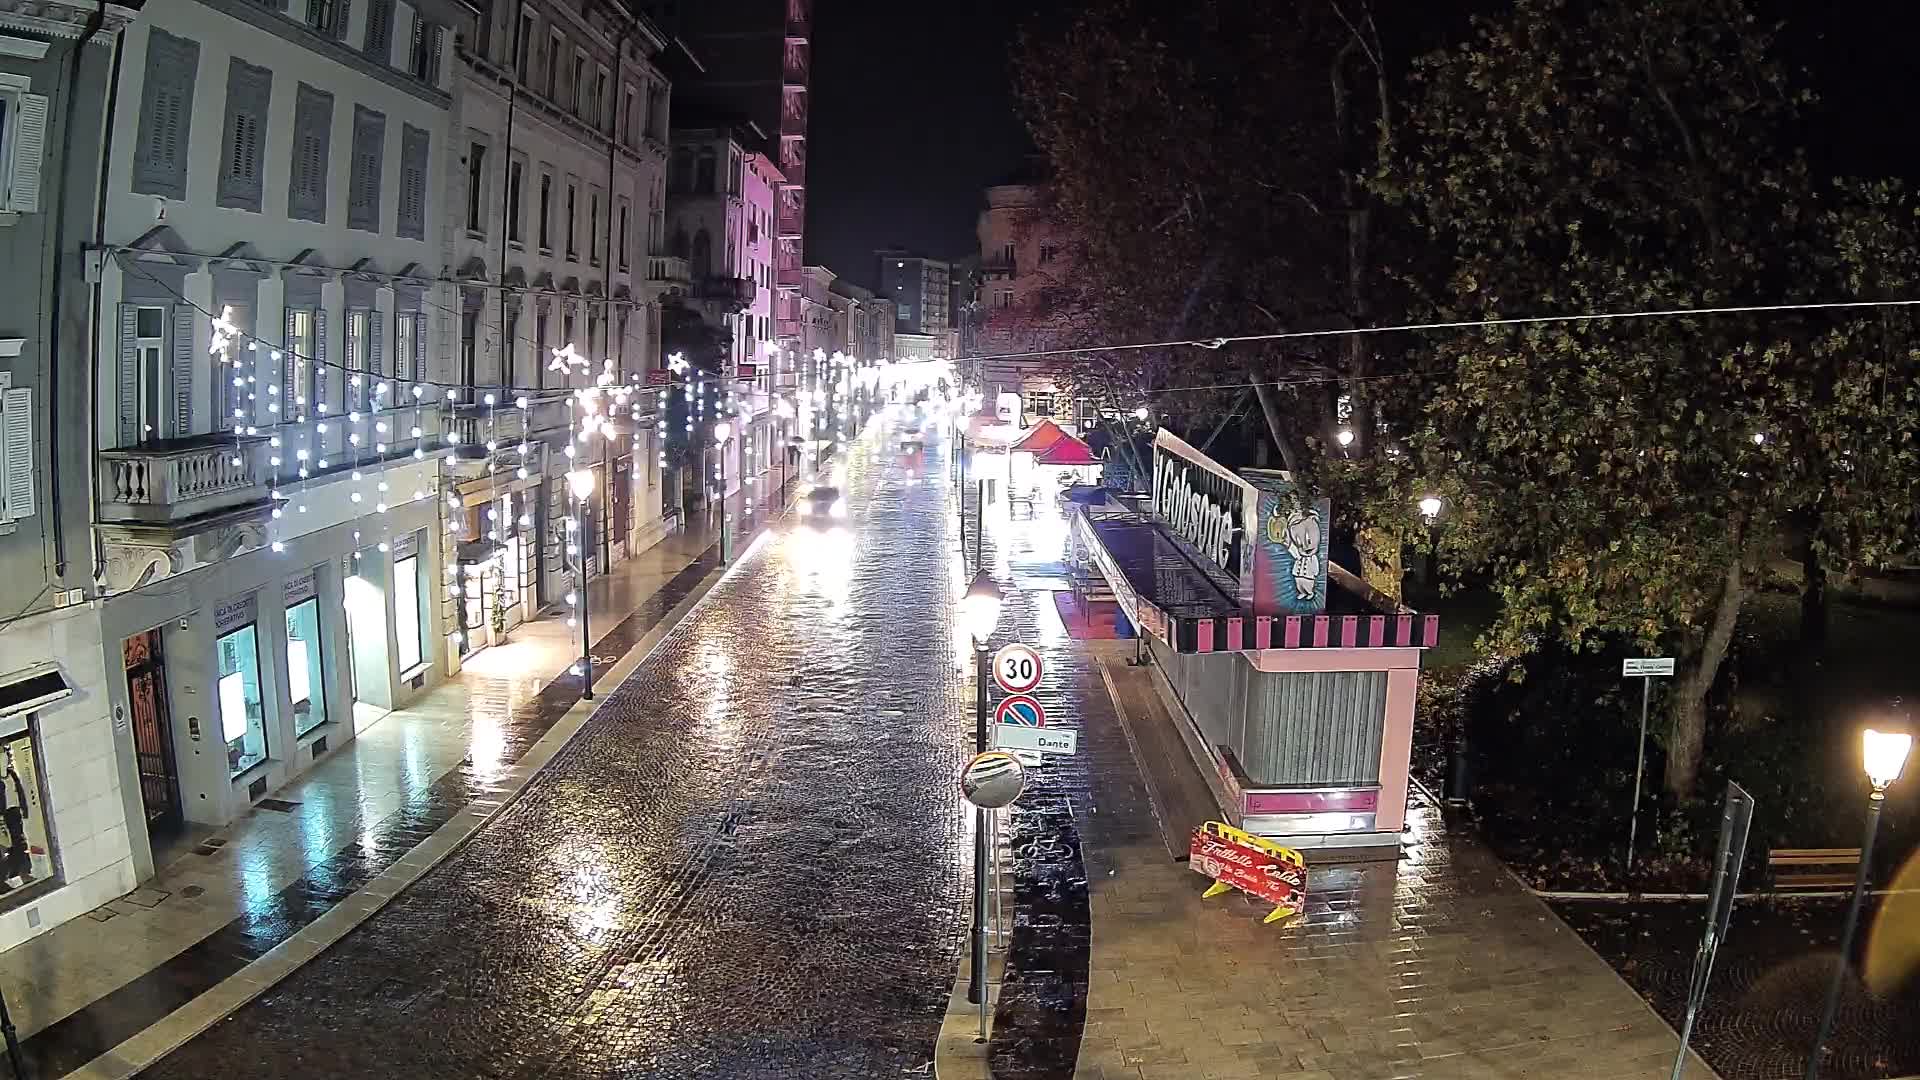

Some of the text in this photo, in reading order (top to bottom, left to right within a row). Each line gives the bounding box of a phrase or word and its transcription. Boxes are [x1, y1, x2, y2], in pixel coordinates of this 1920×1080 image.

[1162, 459, 1232, 569] Golosone
[1006, 658, 1032, 680] 30
[1038, 737, 1069, 749] Dante
[1256, 865, 1301, 886] Calde
